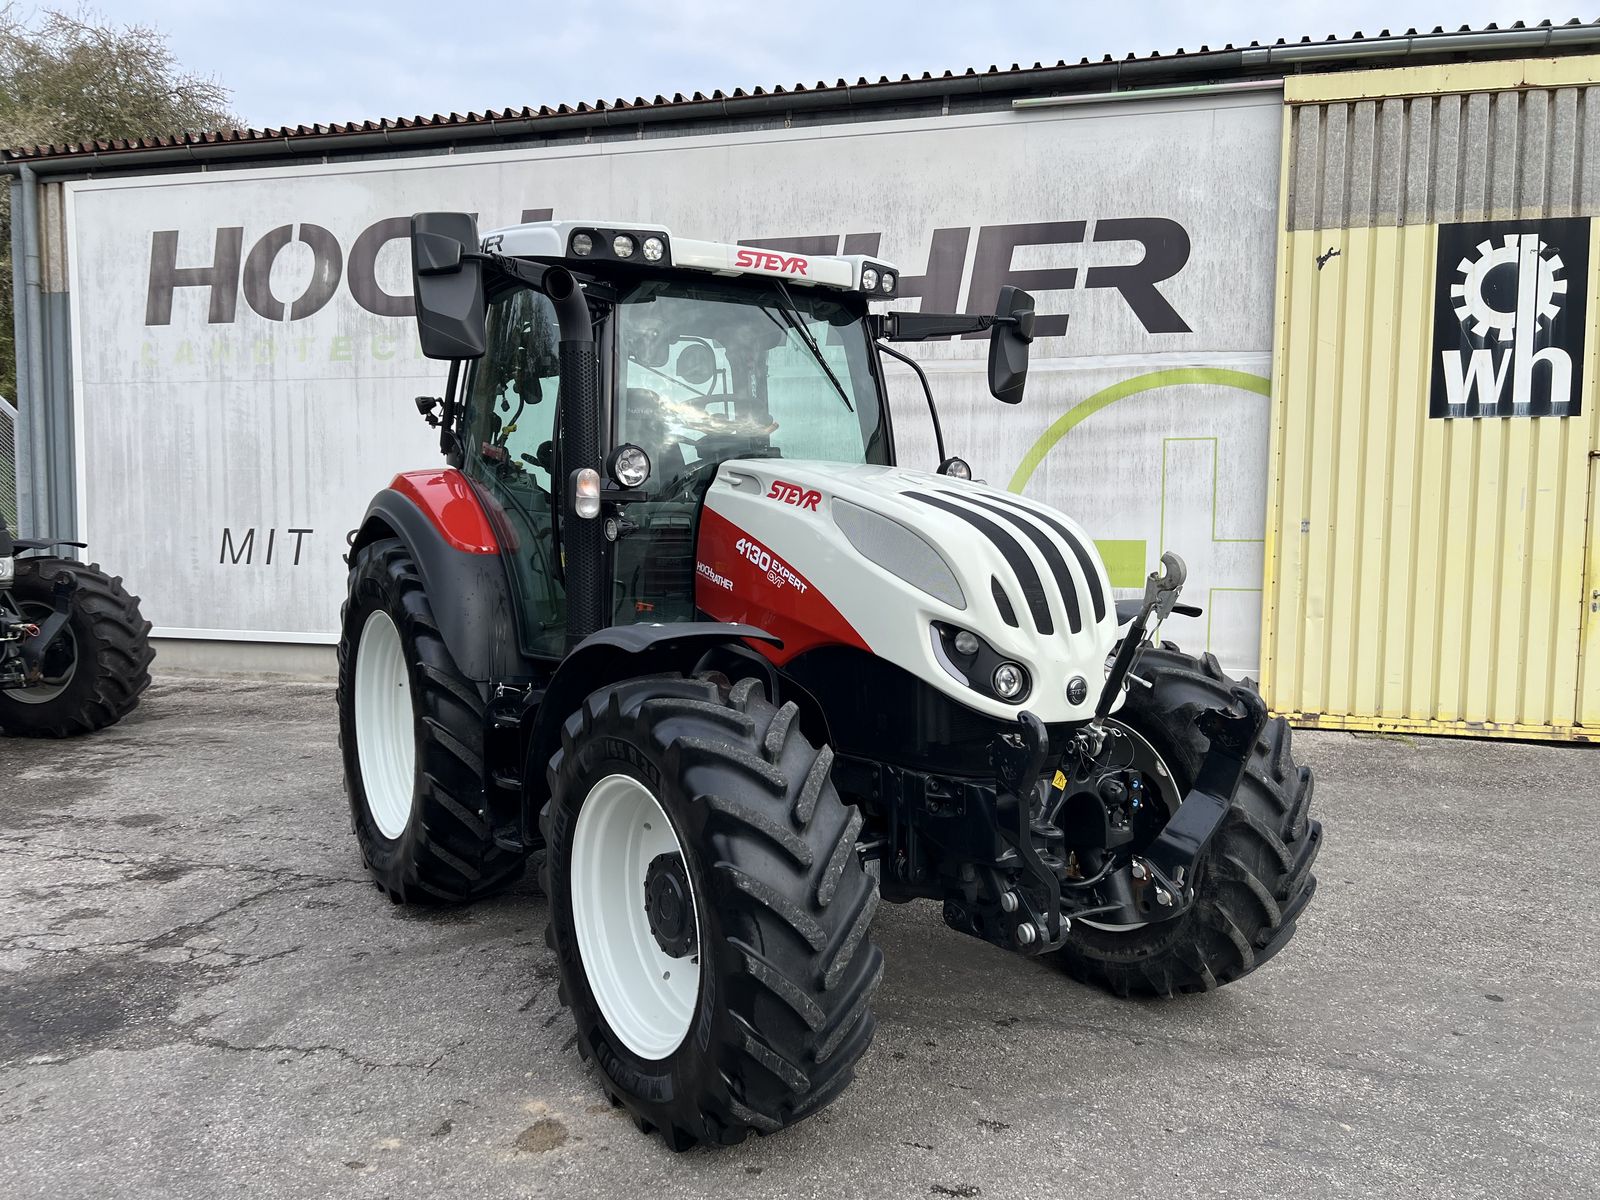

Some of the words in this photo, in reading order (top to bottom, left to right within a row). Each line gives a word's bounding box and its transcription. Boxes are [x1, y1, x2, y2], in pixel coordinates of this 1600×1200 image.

[735, 249, 808, 275] STEYR
[766, 480, 822, 512] STEYR
[219, 527, 314, 566] MIT
[735, 538, 771, 572] 4130
[771, 559, 808, 594] EXPERT
